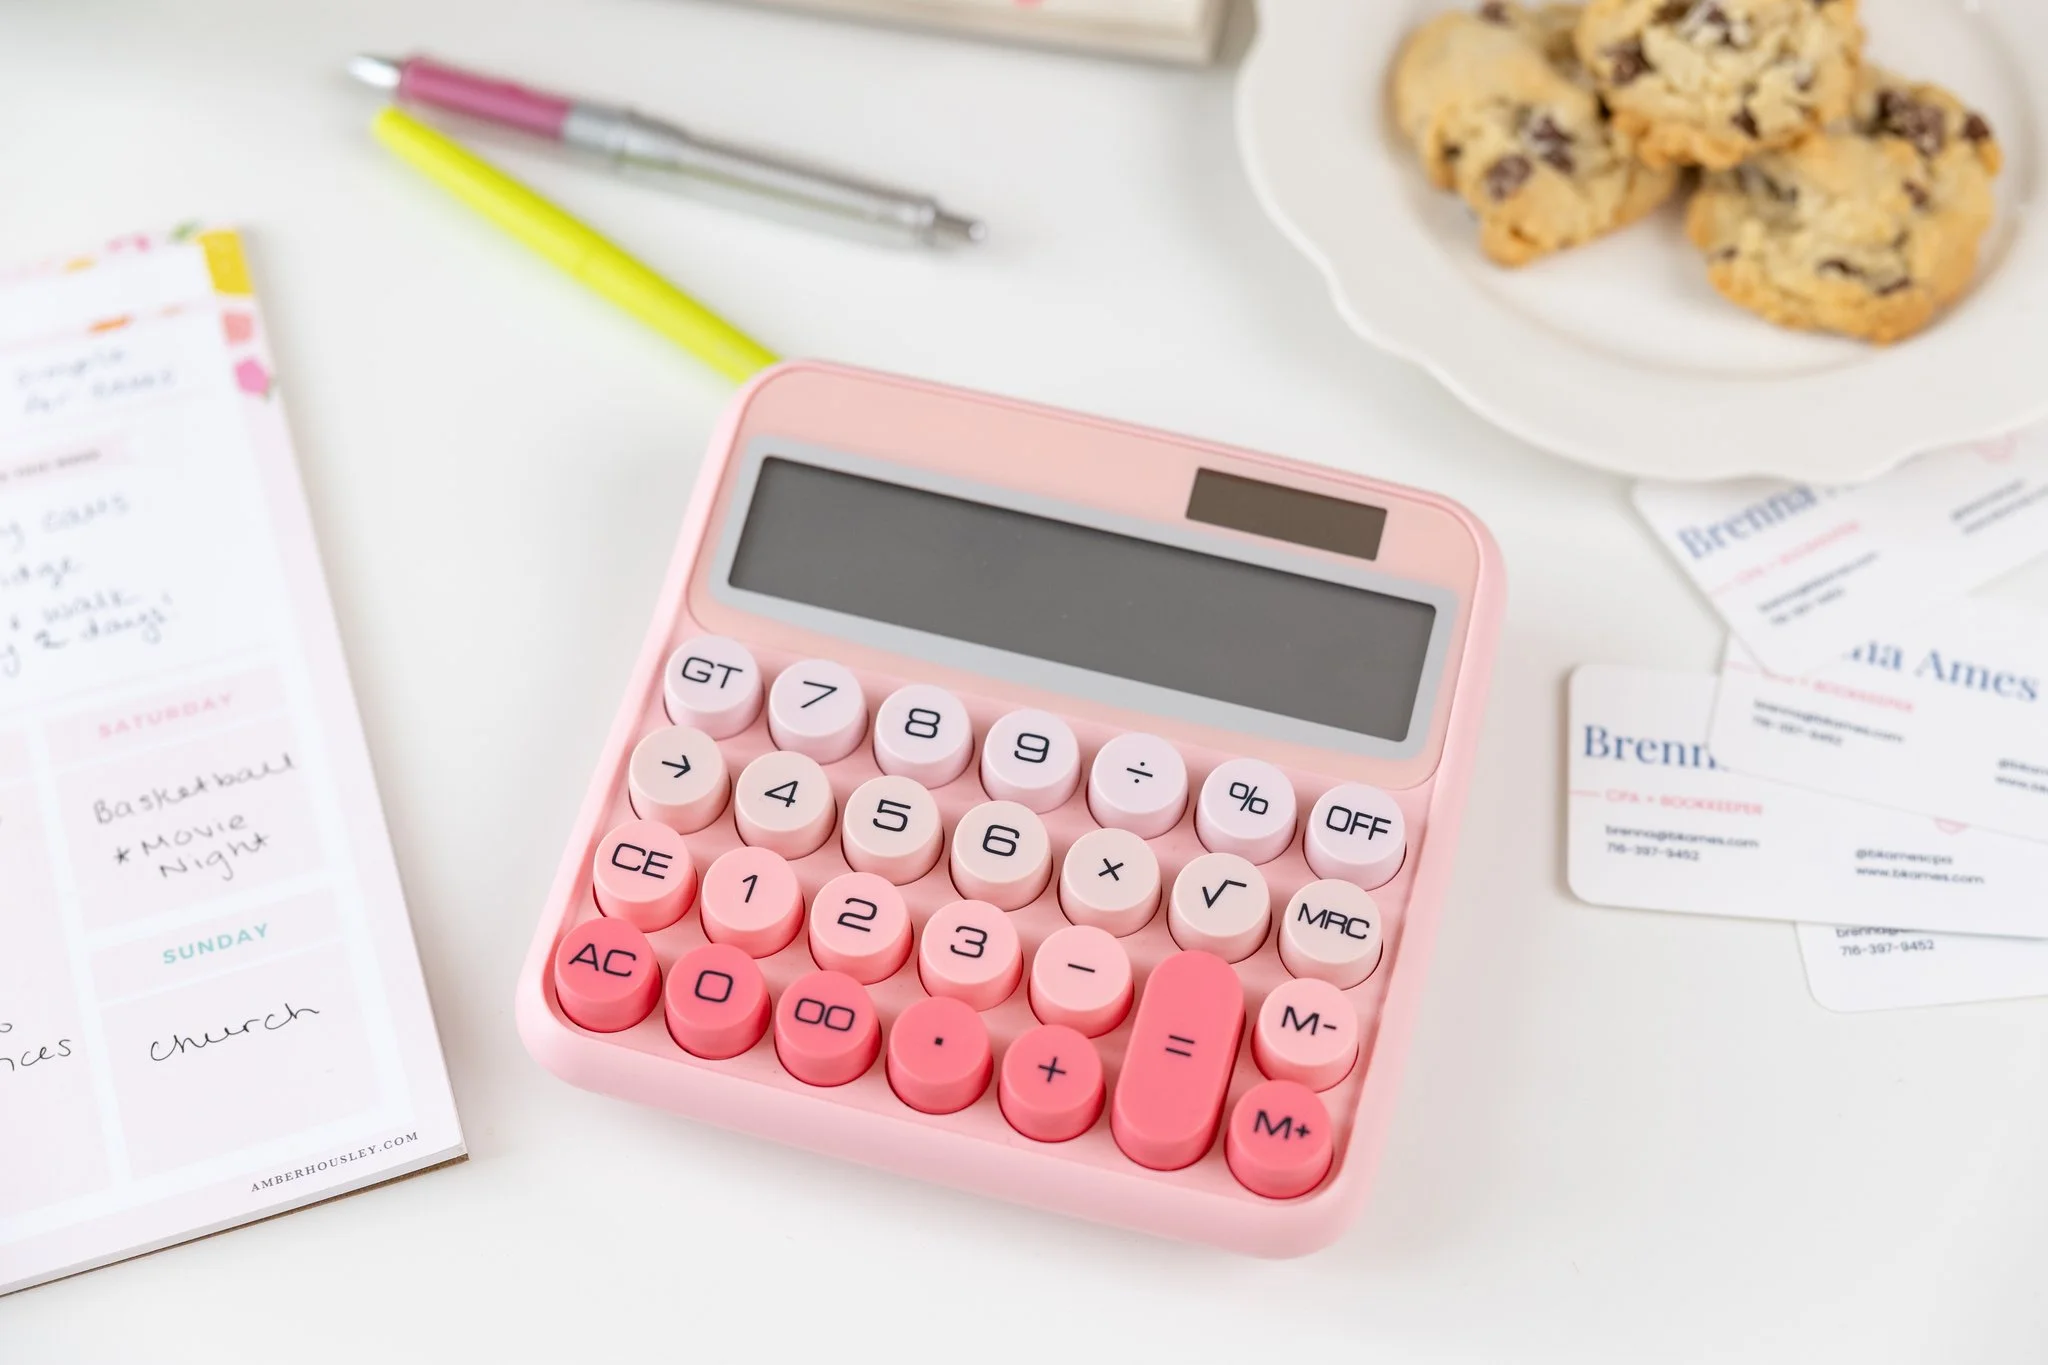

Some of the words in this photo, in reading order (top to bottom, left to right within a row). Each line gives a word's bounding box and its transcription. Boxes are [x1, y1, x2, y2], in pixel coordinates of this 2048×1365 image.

[682, 657, 743, 689] GT
[1913, 649, 2040, 702] Ames
[801, 680, 838, 708] 7
[98, 692, 235, 739] SATURDAY
[905, 708, 941, 739] 8
[1013, 732, 1050, 763] 9
[93, 752, 296, 826] Basketball
[764, 780, 799, 808] 4
[1228, 781, 1270, 816] %
[1605, 788, 1641, 806] CPA
[1660, 794, 1764, 817] BOOKKEEPER
[872, 799, 912, 833] 5
[1325, 805, 1392, 840] OFF
[140, 813, 248, 858] Movie
[982, 824, 1020, 857] 6
[159, 833, 270, 880] Night
[611, 842, 673, 880] CE
[741, 874, 759, 904] 1
[837, 897, 877, 932] 2
[1297, 903, 1370, 940] MRC
[162, 923, 270, 965] SUNDAY
[950, 925, 988, 959] 3
[1840, 939, 1936, 957] 716-397-9452
[568, 942, 637, 978] AC
[694, 970, 734, 1003] 0
[794, 997, 855, 1032] 00
[1281, 1005, 1337, 1036] M-
[1253, 1109, 1312, 1140] M+
[250, 1131, 419, 1193] AMBERHOUSLEY.COM
